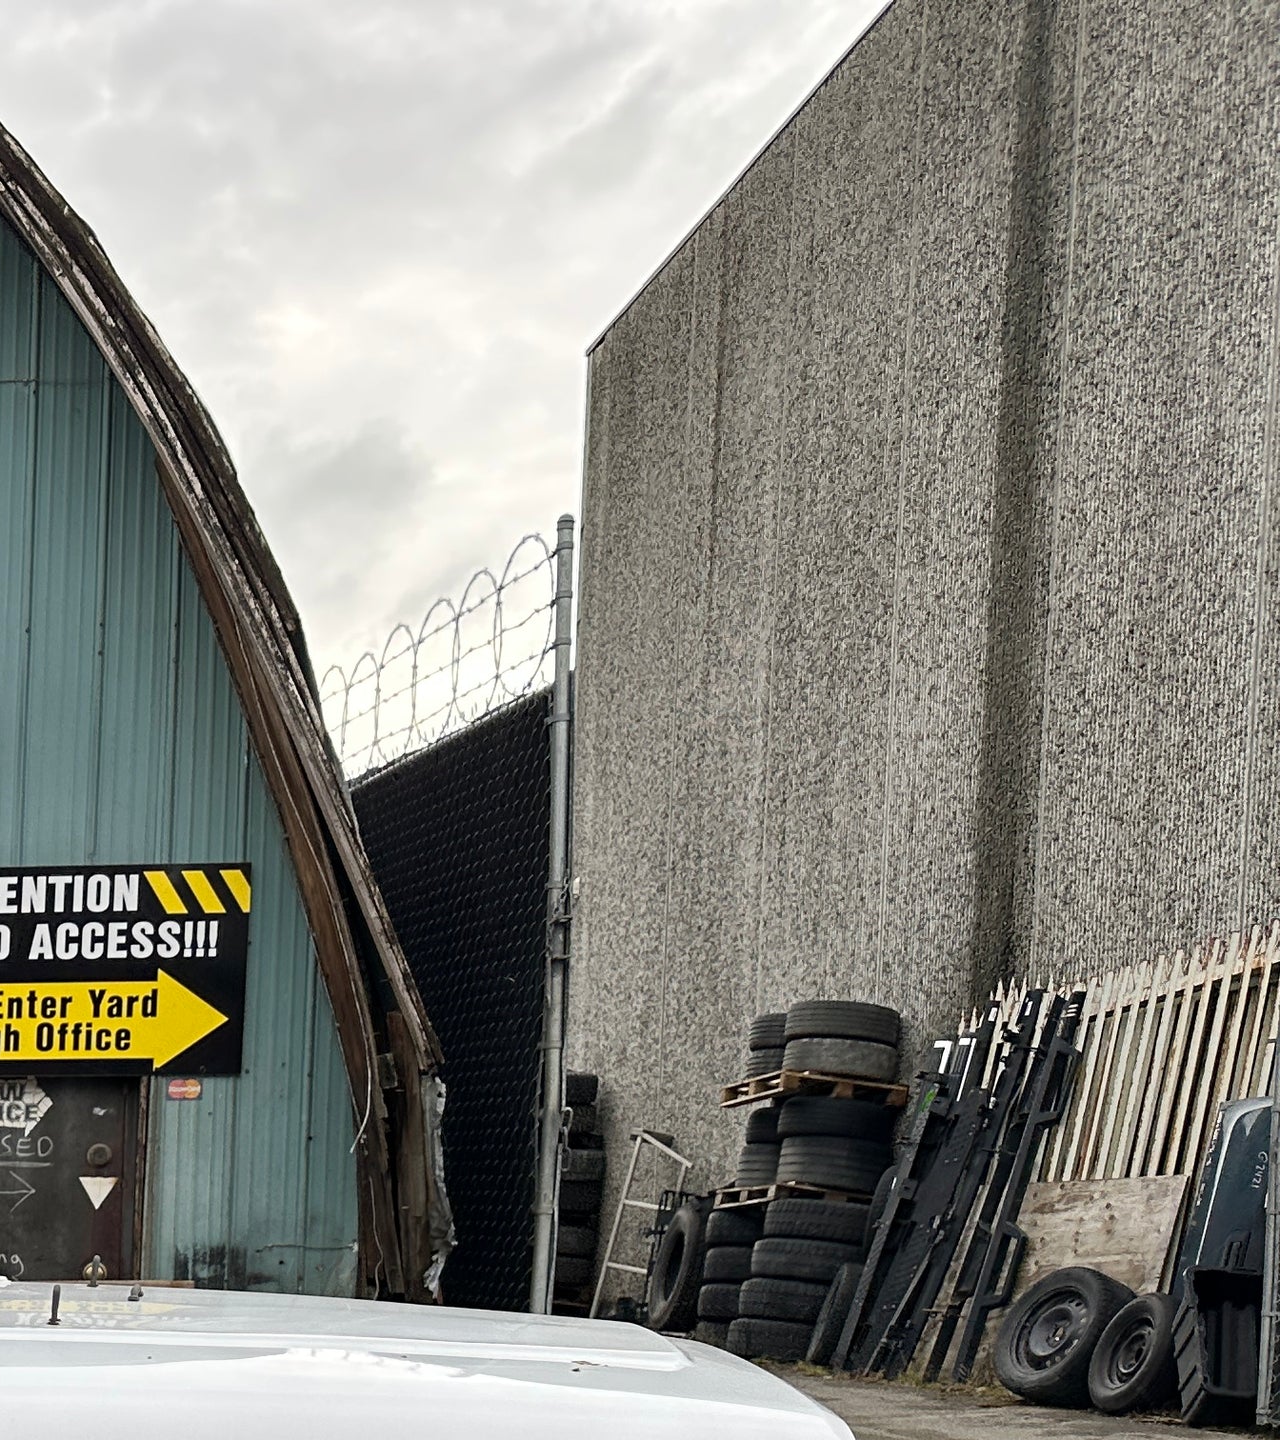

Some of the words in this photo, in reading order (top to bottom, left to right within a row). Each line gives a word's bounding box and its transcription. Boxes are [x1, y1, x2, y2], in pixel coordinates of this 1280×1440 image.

[28, 920, 219, 961] ACCESS!!!
[88, 988, 159, 1018] Yard
[36, 1022, 132, 1052] Office
